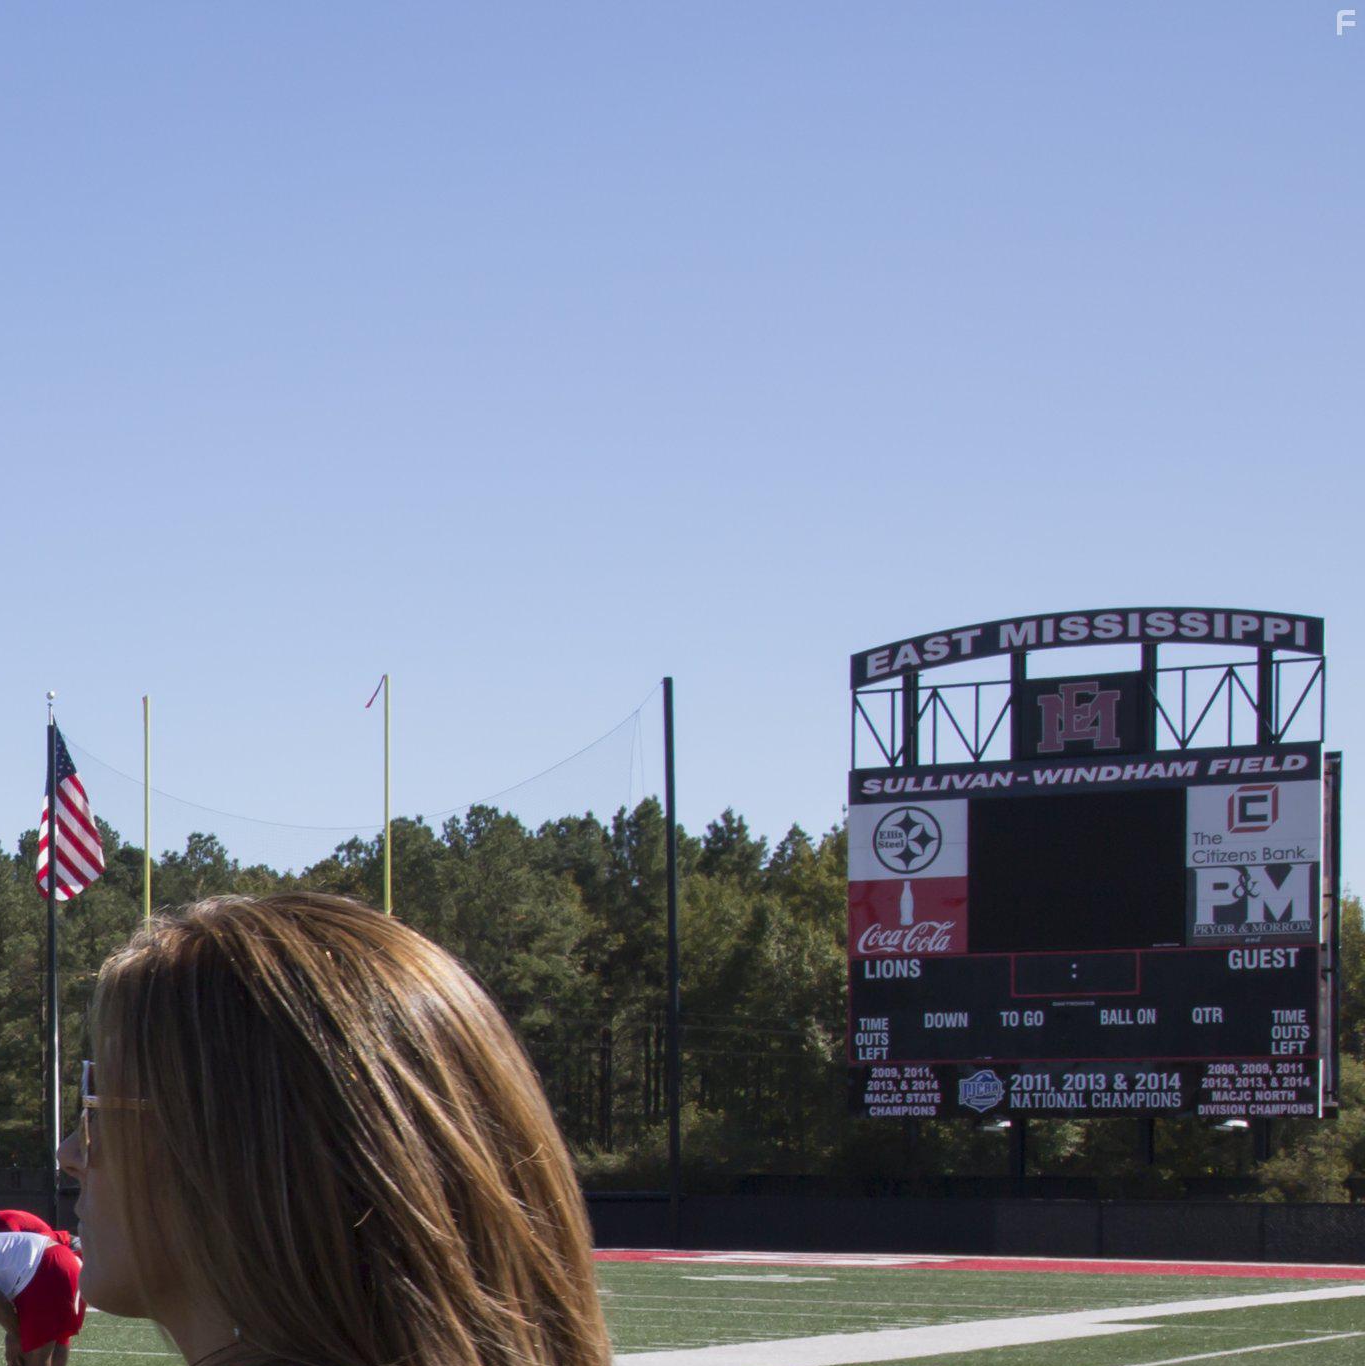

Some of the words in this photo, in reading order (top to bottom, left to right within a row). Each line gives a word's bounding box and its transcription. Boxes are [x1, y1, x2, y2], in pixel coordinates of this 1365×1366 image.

[866, 628, 981, 678] EAST
[999, 612, 1307, 648] MISSISSIPPI
[862, 758, 1197, 794] SULLIVAN-WINDHAM
[1209, 754, 1308, 777] FIELD
[879, 830, 904, 839] Ellis
[1192, 832, 1222, 846] The
[878, 839, 904, 849] Steel
[1192, 849, 1257, 864] Citizens
[1263, 846, 1306, 861] Bank
[1194, 863, 1313, 925] P&M
[1193, 924, 1235, 935] PRYOR
[1239, 924, 1250, 933] &
[1252, 921, 1312, 932] MORROW
[1228, 948, 1300, 970] GUEST
[865, 959, 921, 979] LIONS
[924, 1012, 968, 1029] DOWN
[1000, 1011, 1019, 1027] TO
[1023, 1010, 1044, 1026] GO
[1100, 1009, 1134, 1025] BALL
[1137, 1008, 1156, 1024] ON
[1192, 1007, 1223, 1024] QTR
[1271, 1009, 1306, 1024] TIME
[859, 1018, 889, 1031] TIME
[855, 1032, 889, 1046] OUTS
[1271, 1025, 1310, 1040] OUTS
[858, 1047, 889, 1060] LEFT
[1271, 1041, 1306, 1055] LEFT
[871, 1067, 901, 1079] 2009,
[904, 1067, 934, 1079] 2011,
[1241, 1063, 1272, 1075] 2009,
[1276, 1063, 1303, 1074] 2011
[867, 1080, 896, 1092] 2013,
[900, 1081, 909, 1090] &
[912, 1080, 939, 1091] 2014
[1010, 1073, 1055, 1093] 2011,
[1063, 1073, 1106, 1090] 2013
[1113, 1073, 1128, 1090] &
[1135, 1072, 1181, 1090] 2014
[1201, 1077, 1233, 1089] 2012,
[1235, 1077, 1266, 1089] 2013,
[1270, 1078, 1279, 1087] &
[1282, 1076, 1311, 1088] 2014
[864, 1093, 903, 1104] MACJC
[906, 1093, 941, 1104] STATE
[1010, 1092, 1087, 1108] NATIONAL
[1092, 1091, 1182, 1108] CHAMPIONS
[1211, 1090, 1251, 1101] MACJC
[1255, 1090, 1296, 1101] NORTH
[869, 1105, 936, 1116] CHAMPIONS
[1197, 1104, 1246, 1115] DIVISION
[1249, 1103, 1314, 1115] CHAMPIONS
